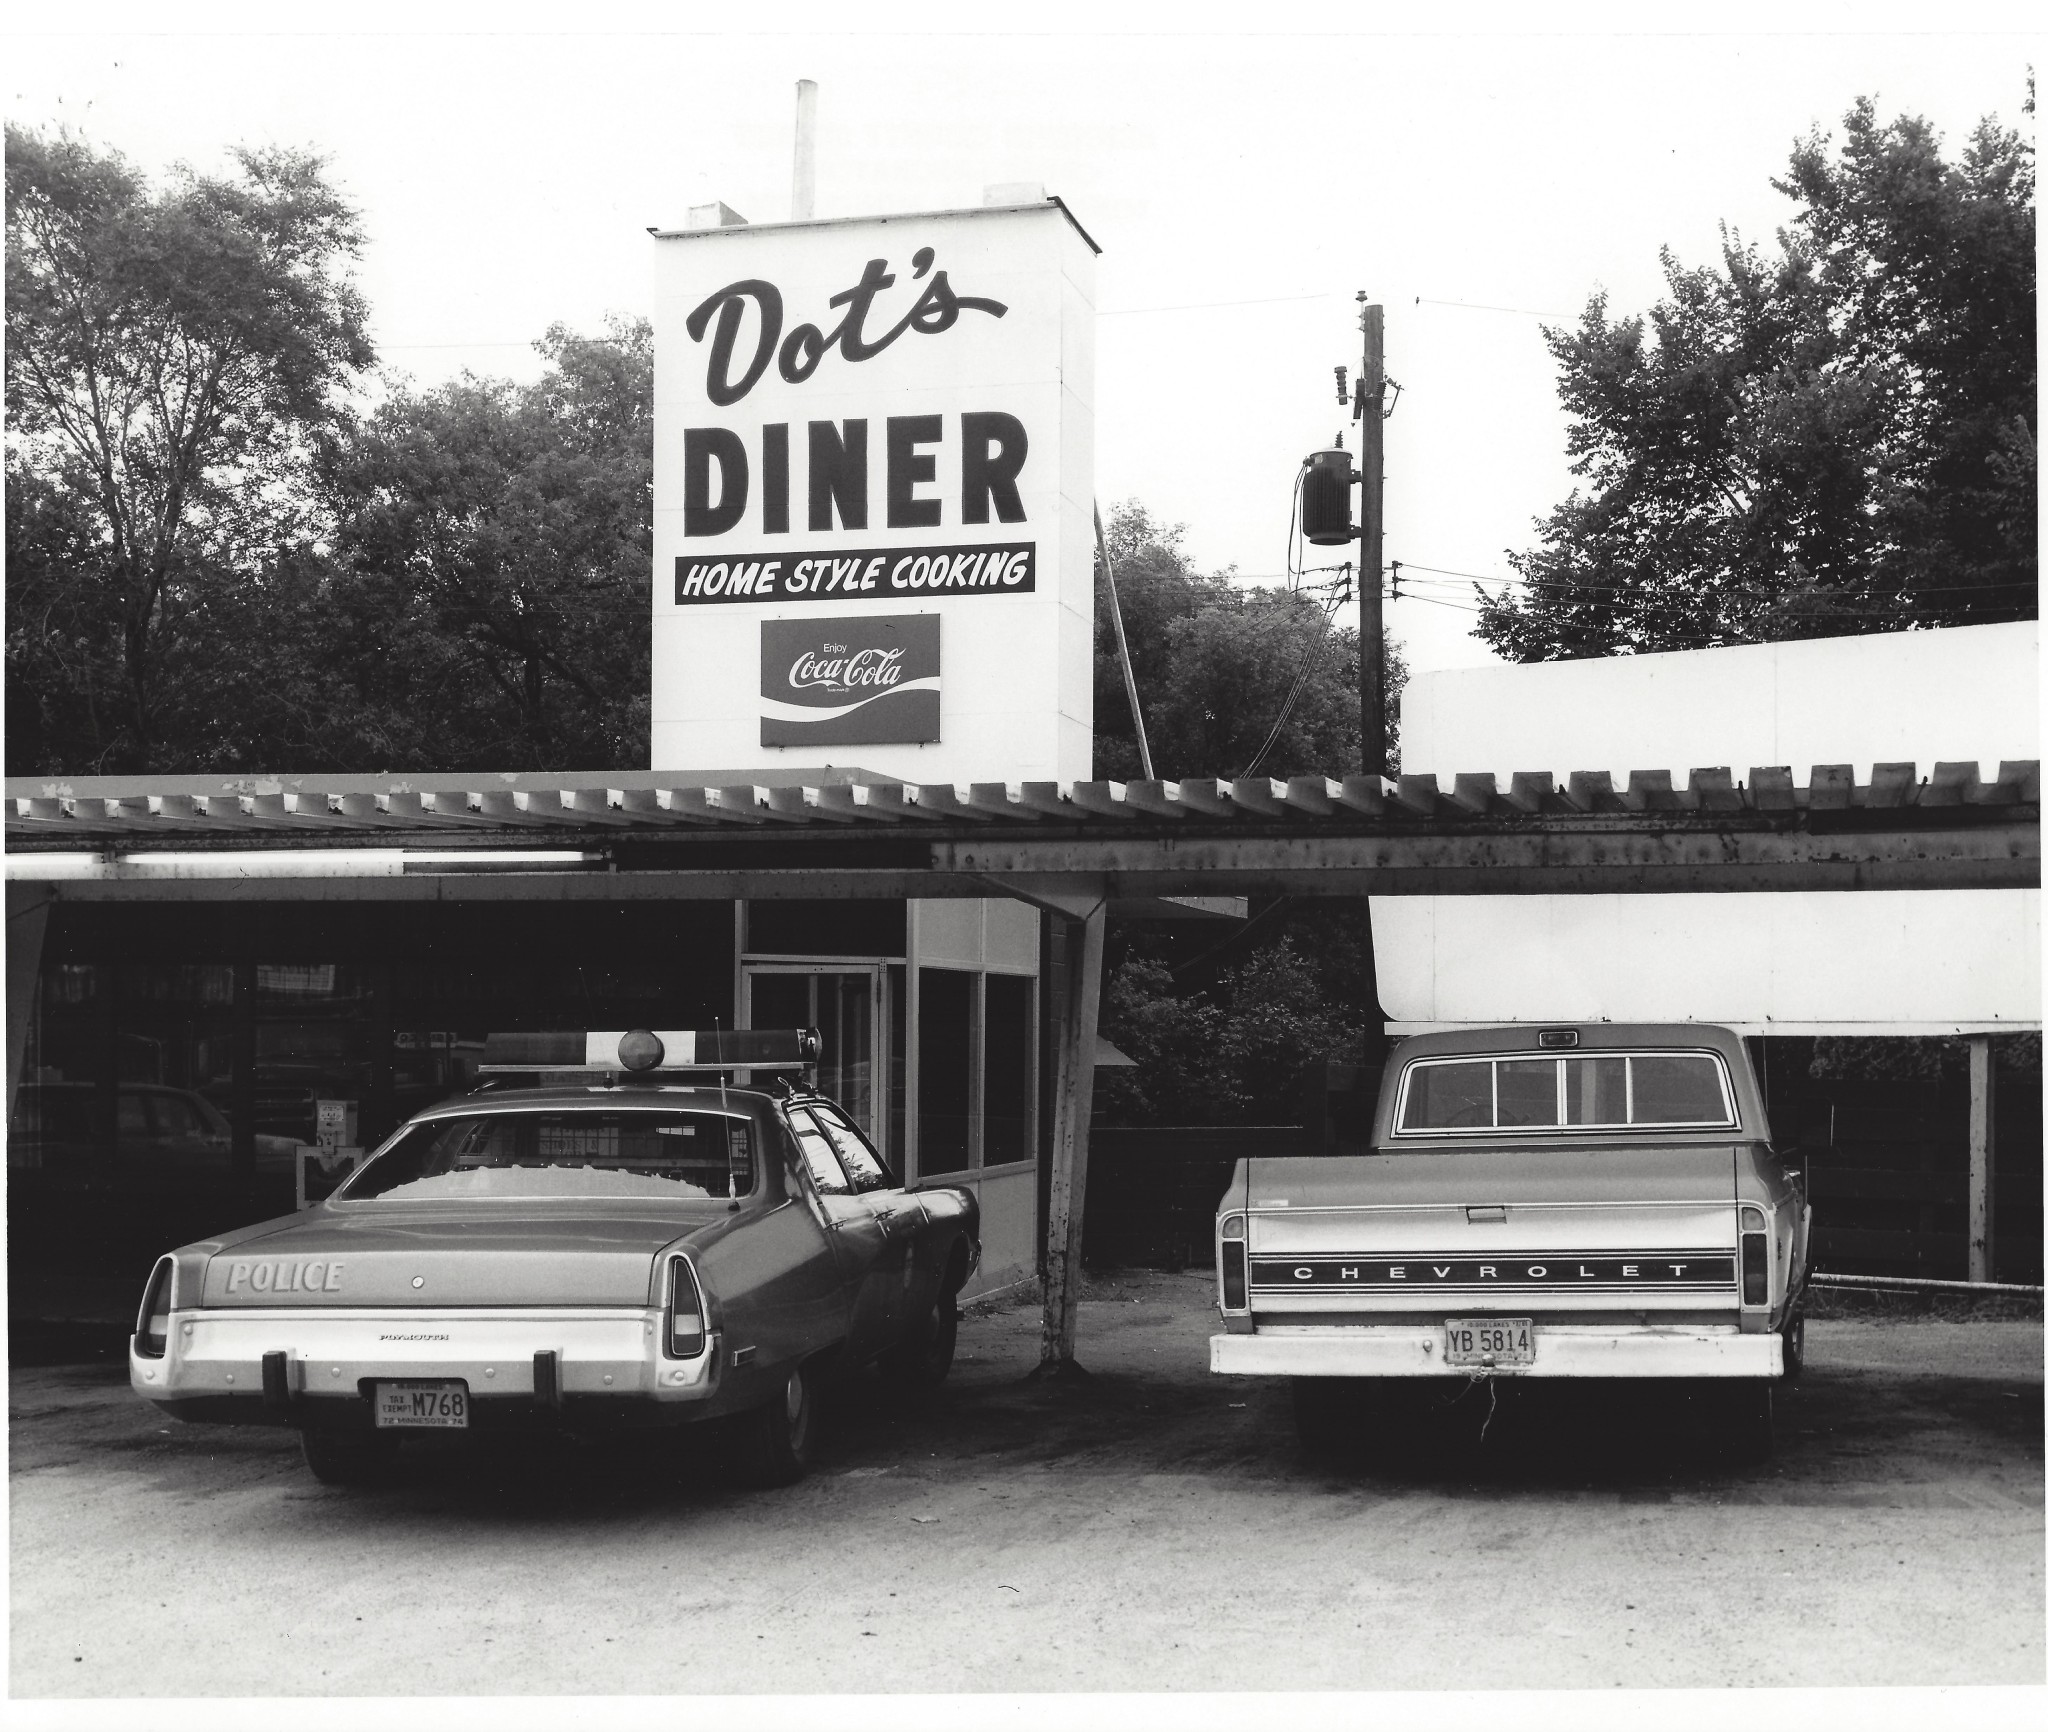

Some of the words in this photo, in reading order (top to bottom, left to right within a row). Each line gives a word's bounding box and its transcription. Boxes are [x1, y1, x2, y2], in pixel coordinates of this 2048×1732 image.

[686, 246, 1008, 406] Dot's
[683, 411, 1029, 537] DINER
[682, 561, 784, 596] HOME
[785, 556, 889, 593] STYLE
[892, 551, 1030, 588] COOKING
[823, 643, 847, 653] Enjoy
[789, 648, 907, 688] Coca-Cola
[225, 1261, 344, 1294] POLICE
[1293, 1264, 1689, 1280] CHEVROLET
[1449, 1330, 1473, 1352] YB
[1480, 1329, 1529, 1352] 5814
[382, 1404, 412, 1413] EXEMPT
[389, 1395, 404, 1403] TAX
[412, 1392, 464, 1417] M768
[397, 1417, 448, 1425] MINNESOTA
